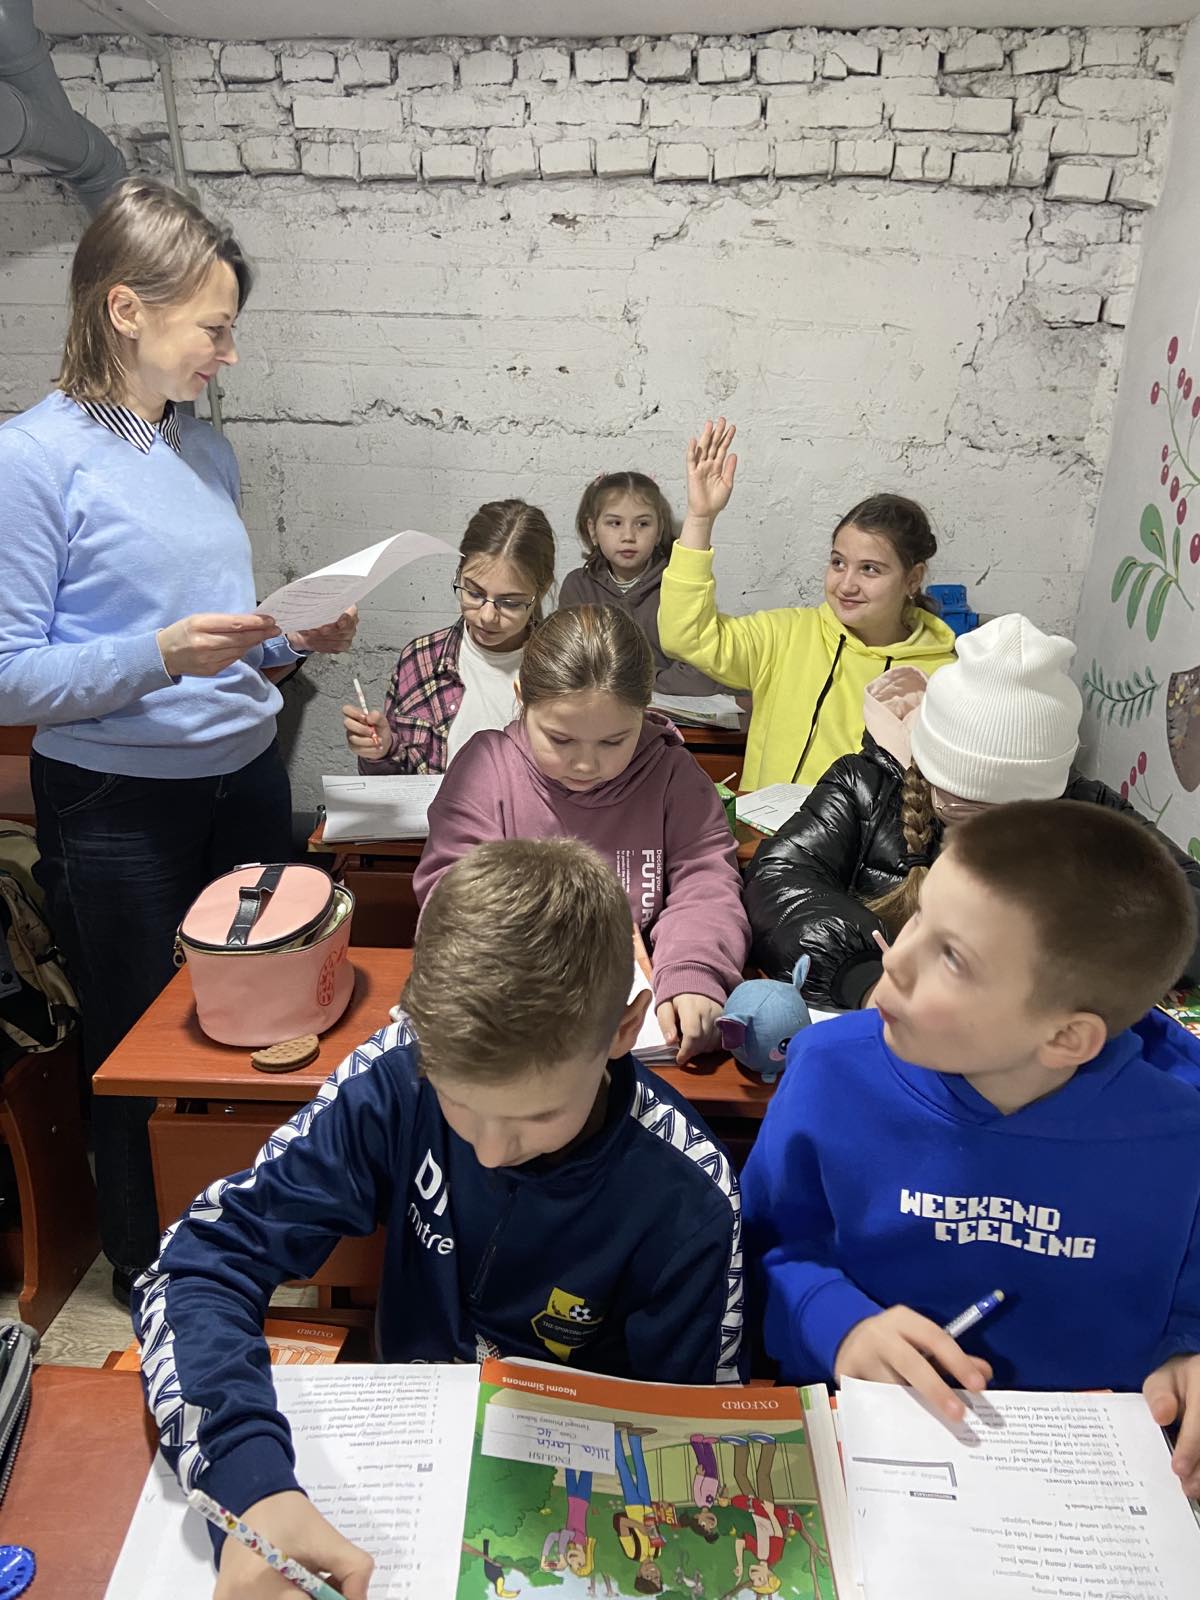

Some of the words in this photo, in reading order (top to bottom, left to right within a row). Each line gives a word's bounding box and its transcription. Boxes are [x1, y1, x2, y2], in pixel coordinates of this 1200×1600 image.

[642, 850, 655, 927] FUTUR
[900, 1188, 1060, 1232] WEEKEND
[408, 1203, 454, 1254] mitre
[935, 1220, 1096, 1258] FEELING
[297, 1328, 334, 1338] OXFORD
[502, 1376, 544, 1391] Simmons
[546, 1385, 576, 1396] Naomi
[722, 1400, 778, 1409] OXFORD
[537, 1427, 551, 1438] 4C
[537, 1438, 570, 1454] Larin
[528, 1451, 571, 1465] ENGLISH
